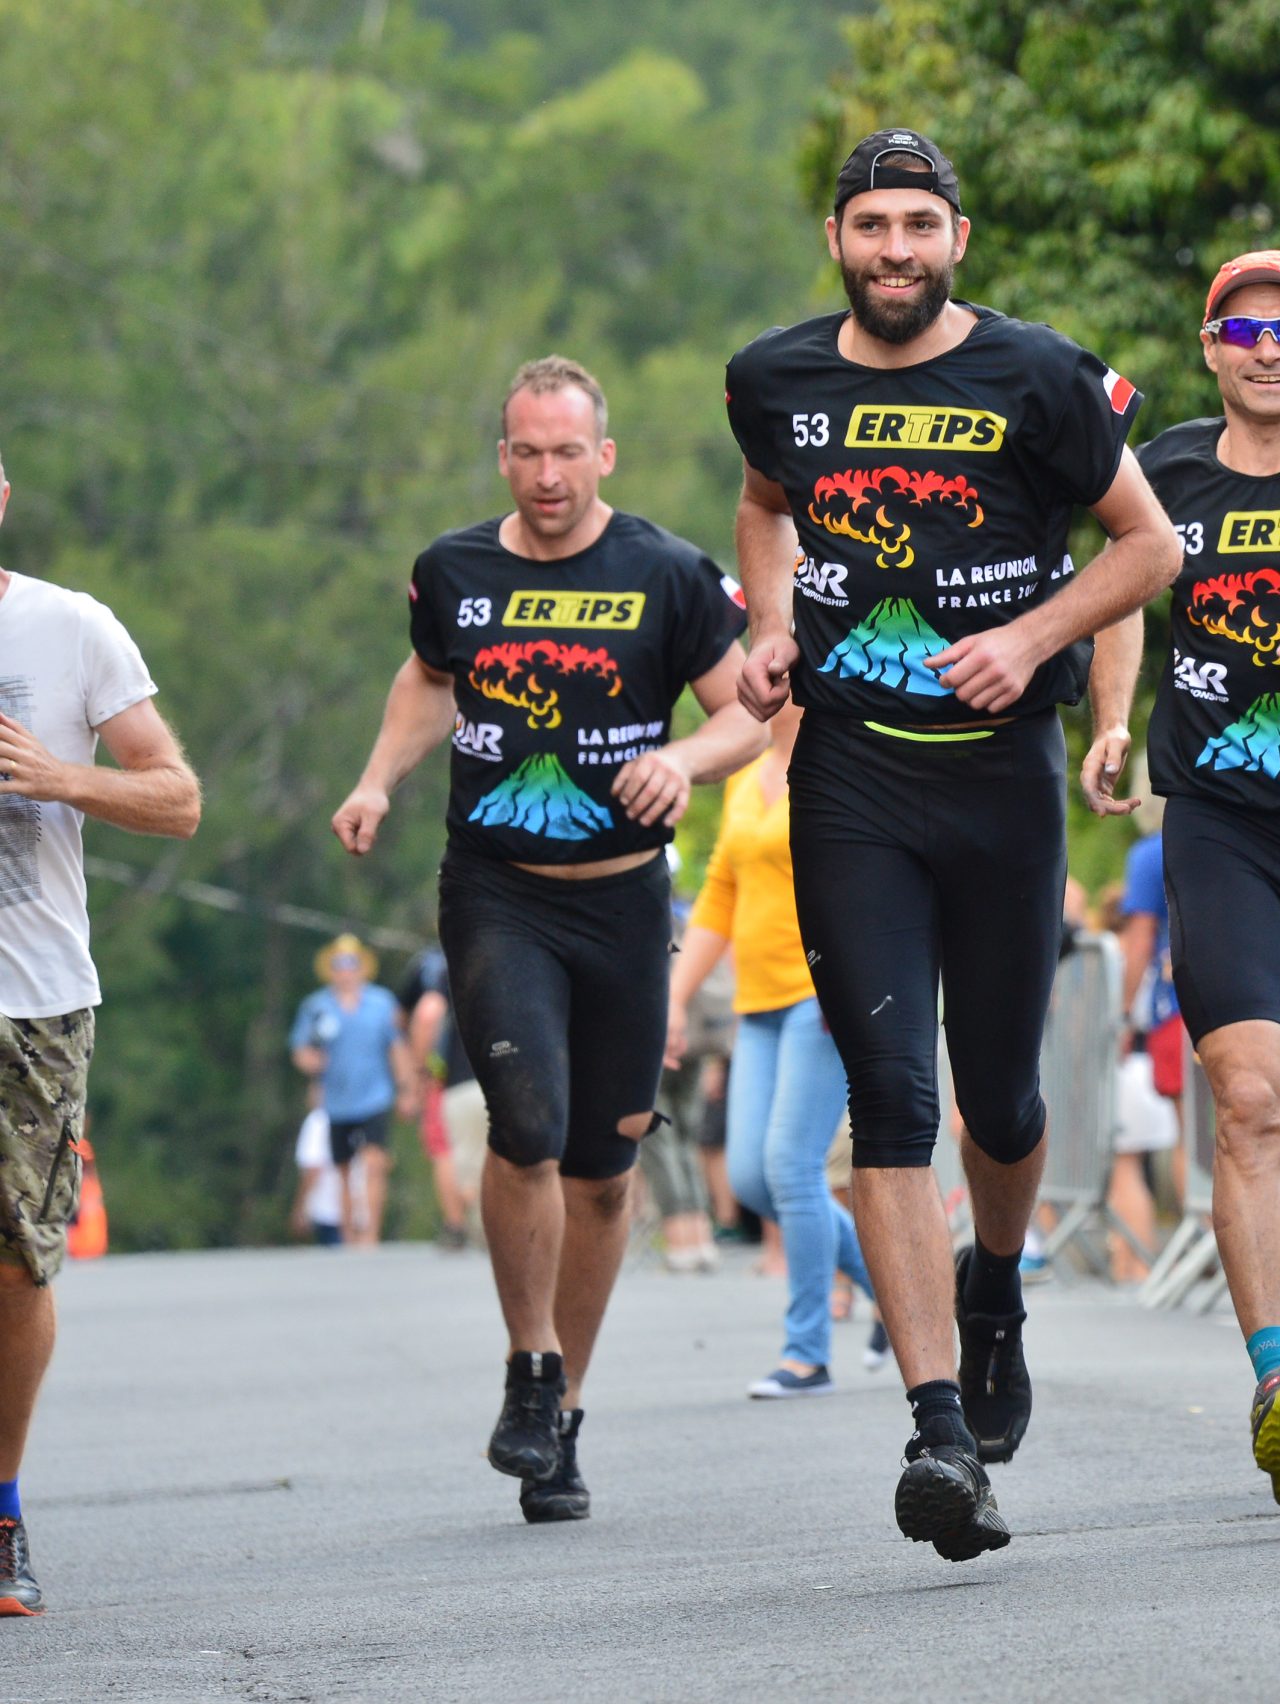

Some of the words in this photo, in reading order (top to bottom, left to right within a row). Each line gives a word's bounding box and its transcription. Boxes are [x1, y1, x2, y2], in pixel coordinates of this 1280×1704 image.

[792, 413, 829, 447] 53
[936, 568, 966, 587] LA
[970, 554, 1038, 584] REUNION
[457, 598, 491, 628] 53
[938, 590, 1012, 609] FRANCE
[577, 728, 604, 746] LA
